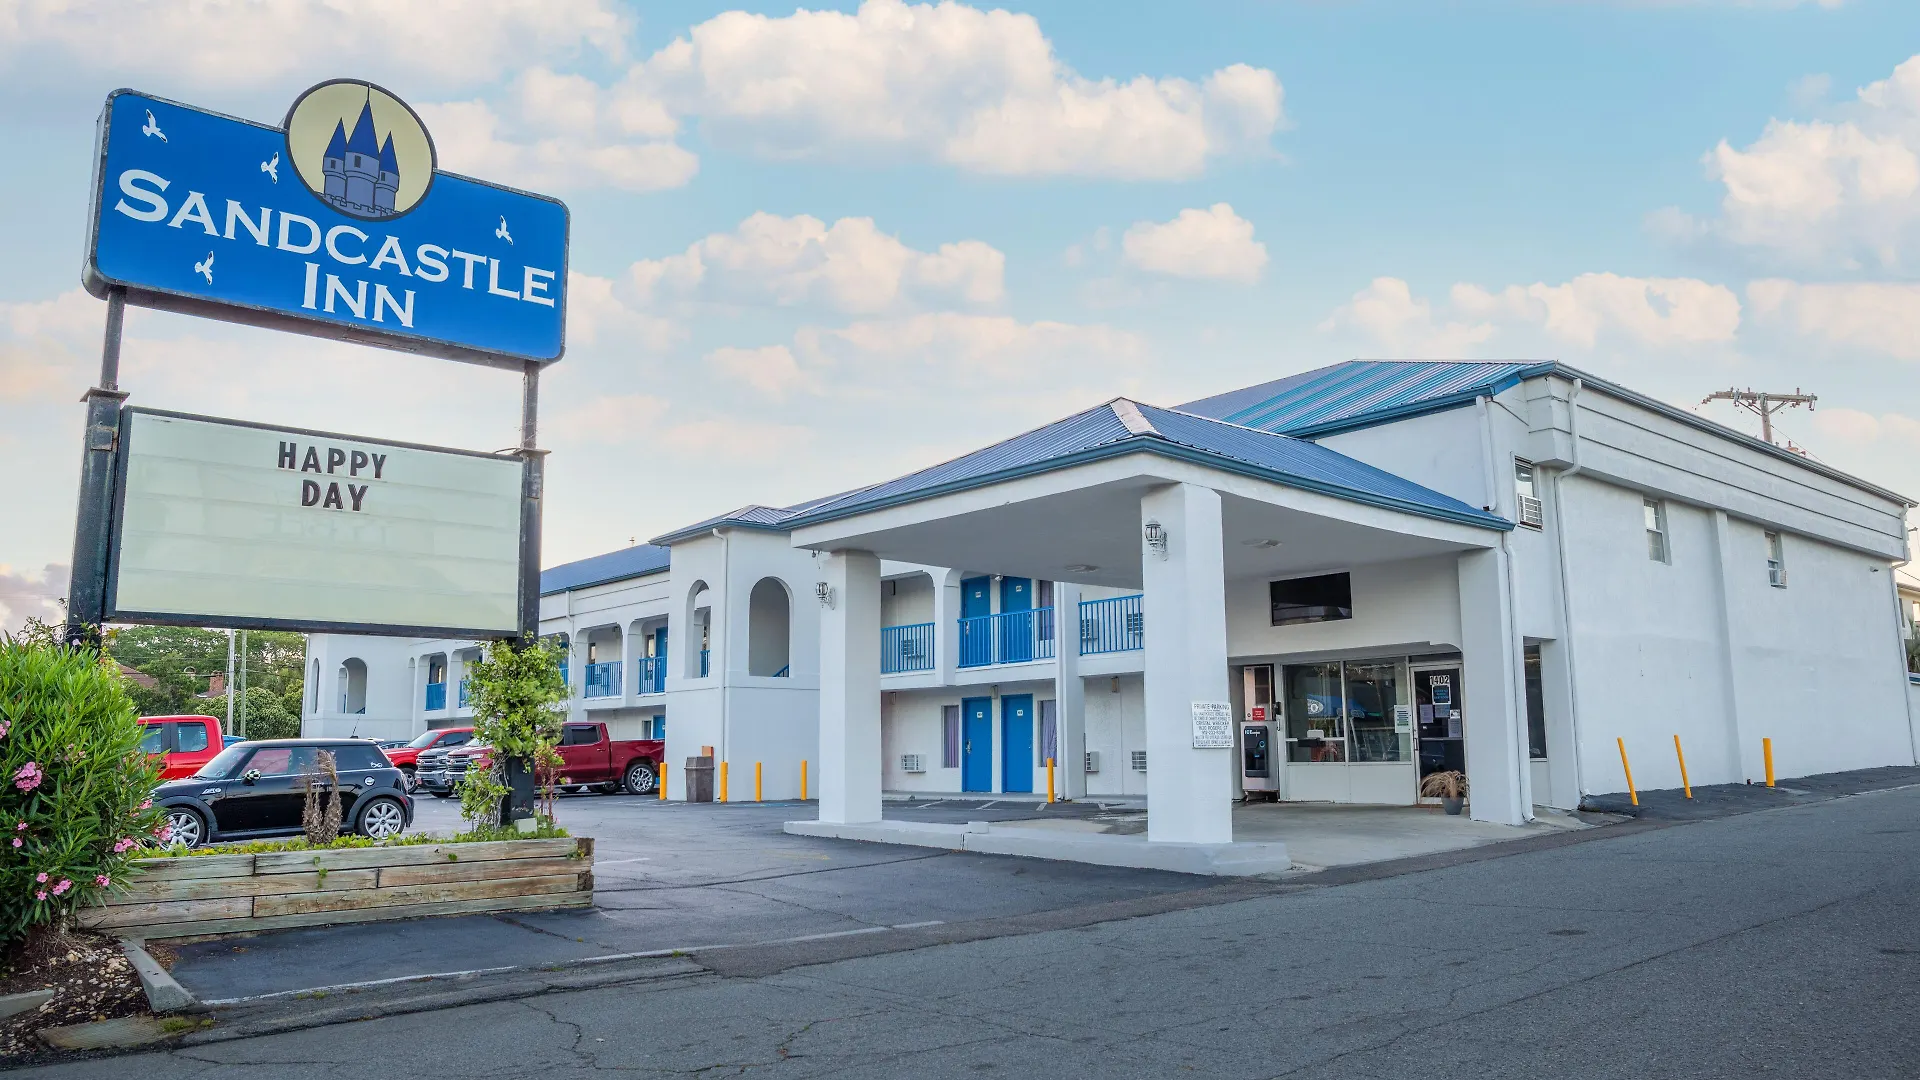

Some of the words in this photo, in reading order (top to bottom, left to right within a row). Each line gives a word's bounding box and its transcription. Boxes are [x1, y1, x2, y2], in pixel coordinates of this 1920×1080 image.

[115, 169, 555, 307] SANDCASTLE
[301, 261, 416, 327] INN
[278, 441, 387, 478] HAPPY
[301, 480, 369, 511] DAY
[1430, 675, 1449, 685] 1402
[1211, 703, 1230, 711] PARKING
